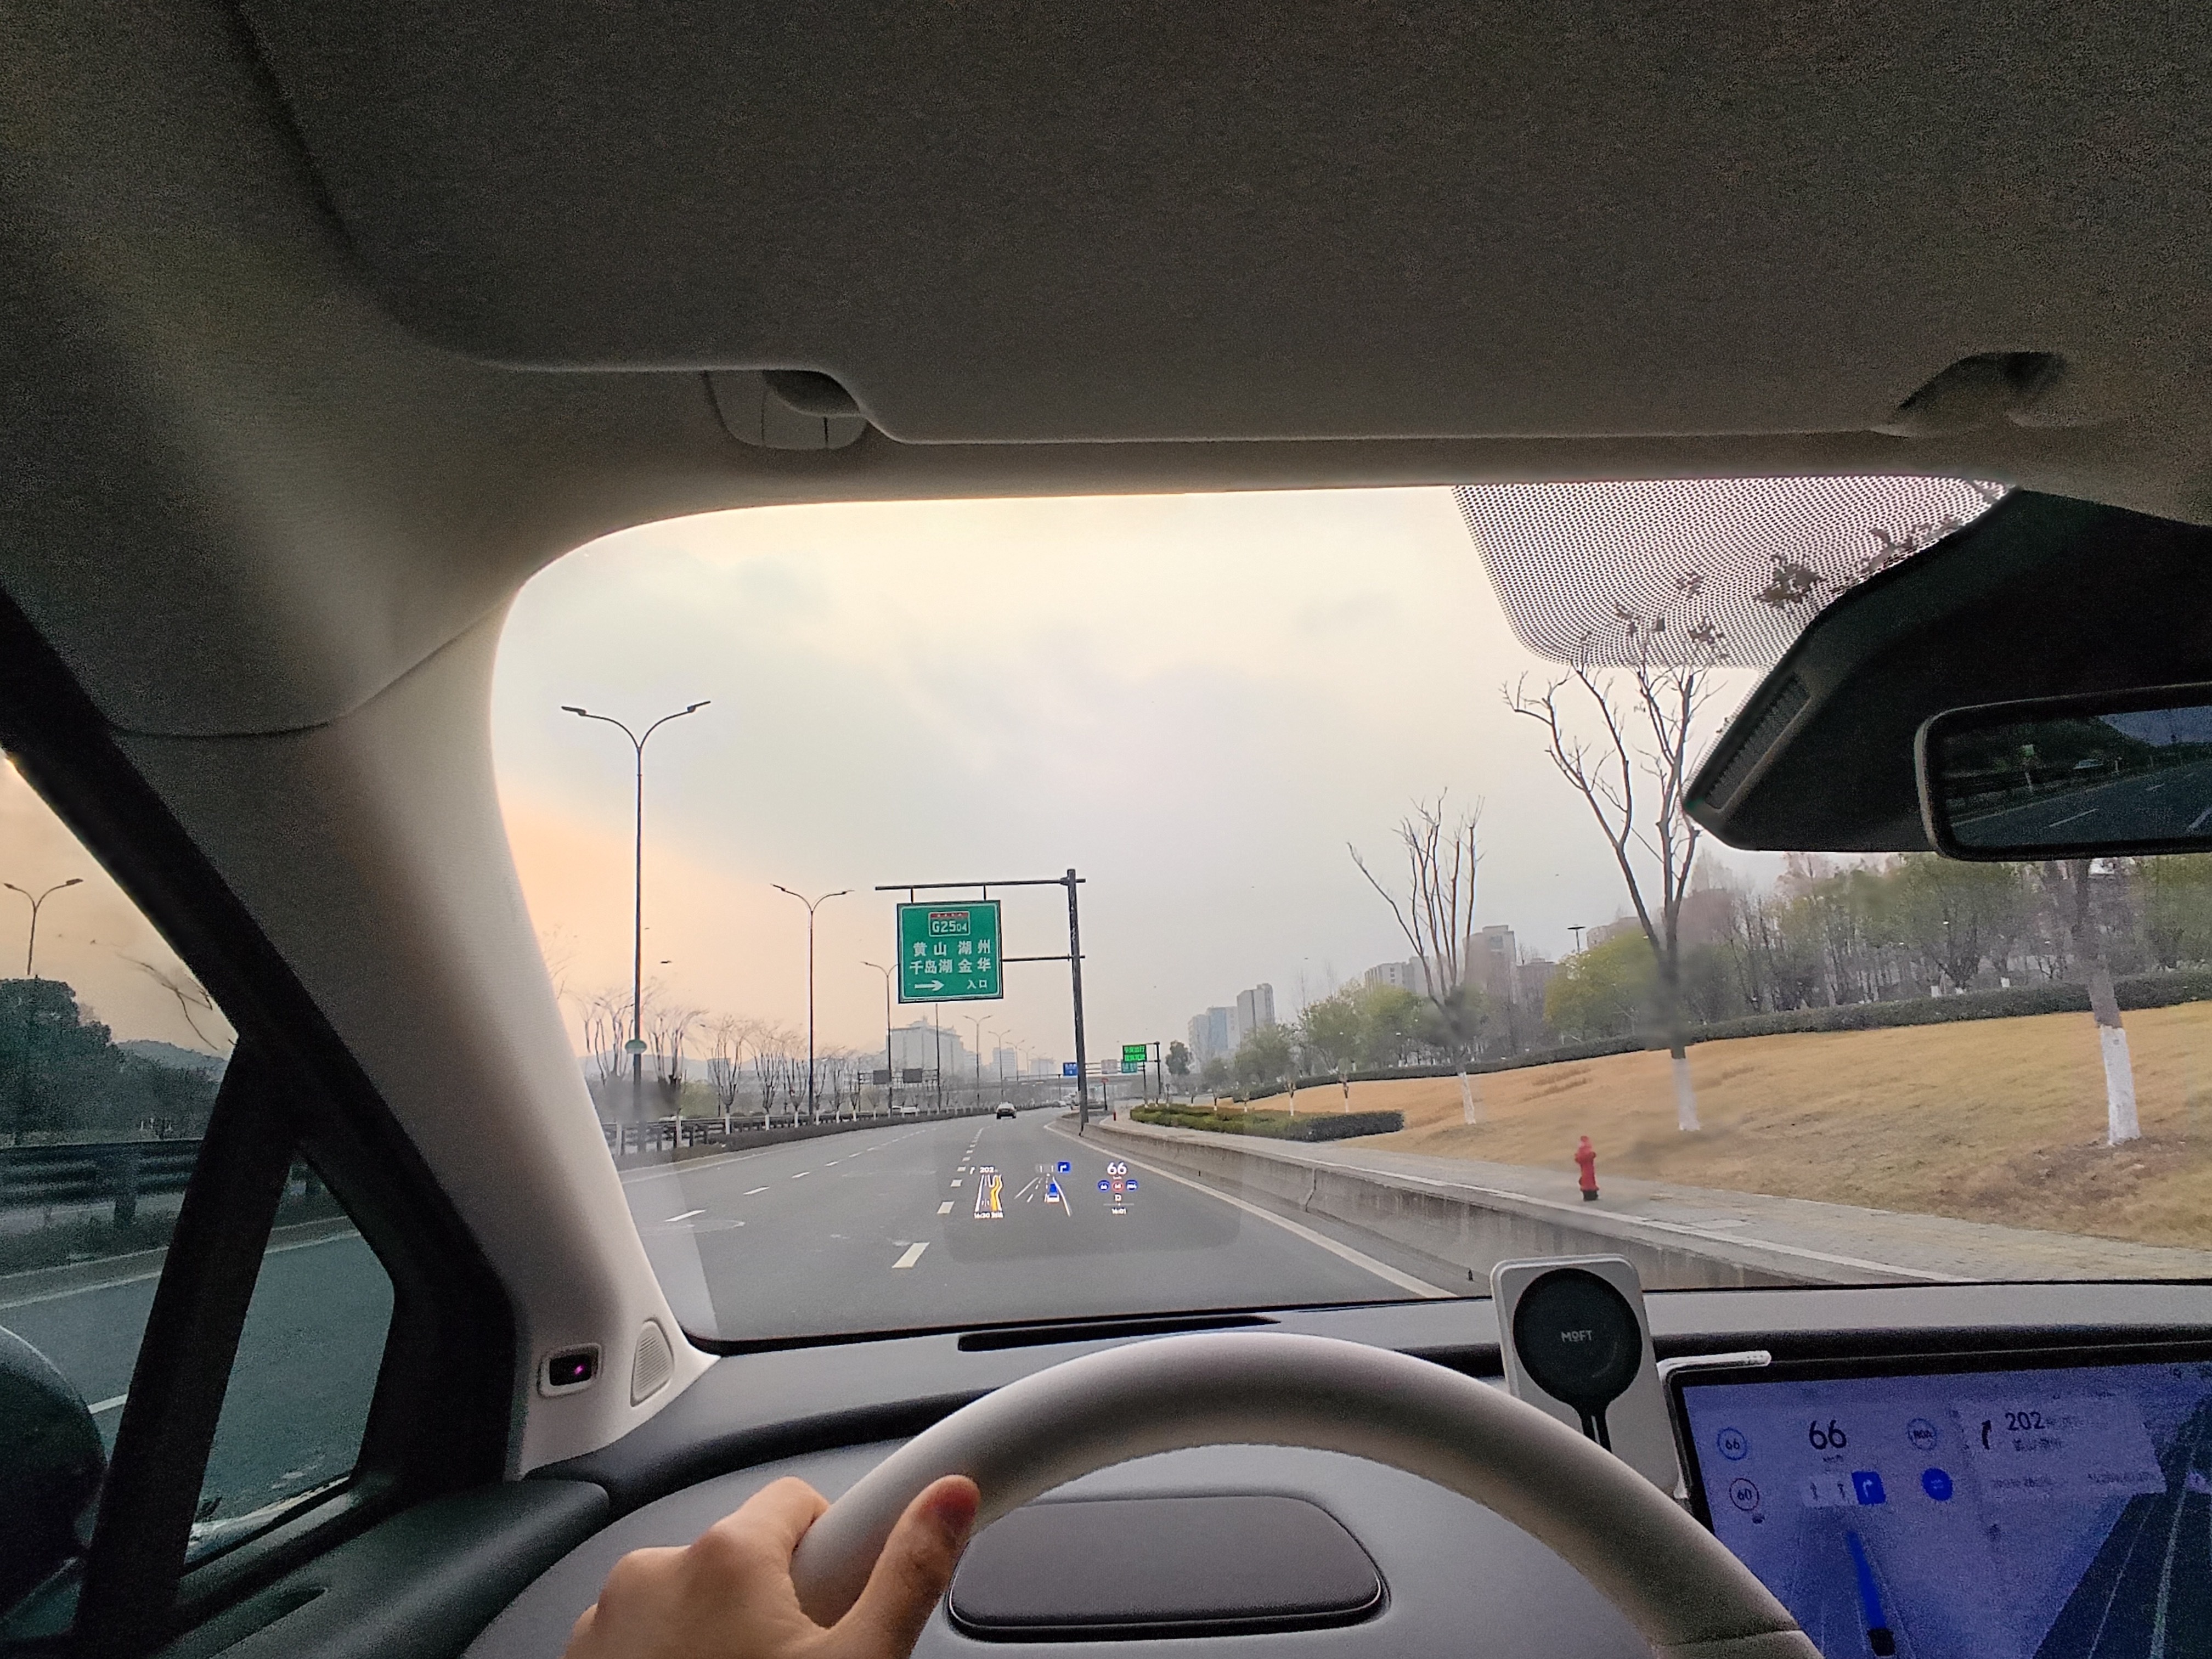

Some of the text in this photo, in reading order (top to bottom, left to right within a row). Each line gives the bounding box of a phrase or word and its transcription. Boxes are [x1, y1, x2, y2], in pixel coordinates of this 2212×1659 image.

[932, 921, 967, 933] G2504
[913, 939, 991, 957] 黄山 湖州
[910, 957, 991, 975] 千岛湖 金华
[967, 979, 988, 990] 入口
[1107, 1162, 1127, 1175] 66
[1561, 1330, 1593, 1342] MOFT
[2005, 1411, 2045, 1430] 202
[1809, 1420, 1847, 1450] 66
[1725, 1438, 1740, 1451] 66
[1737, 1488, 1752, 1501] 60
